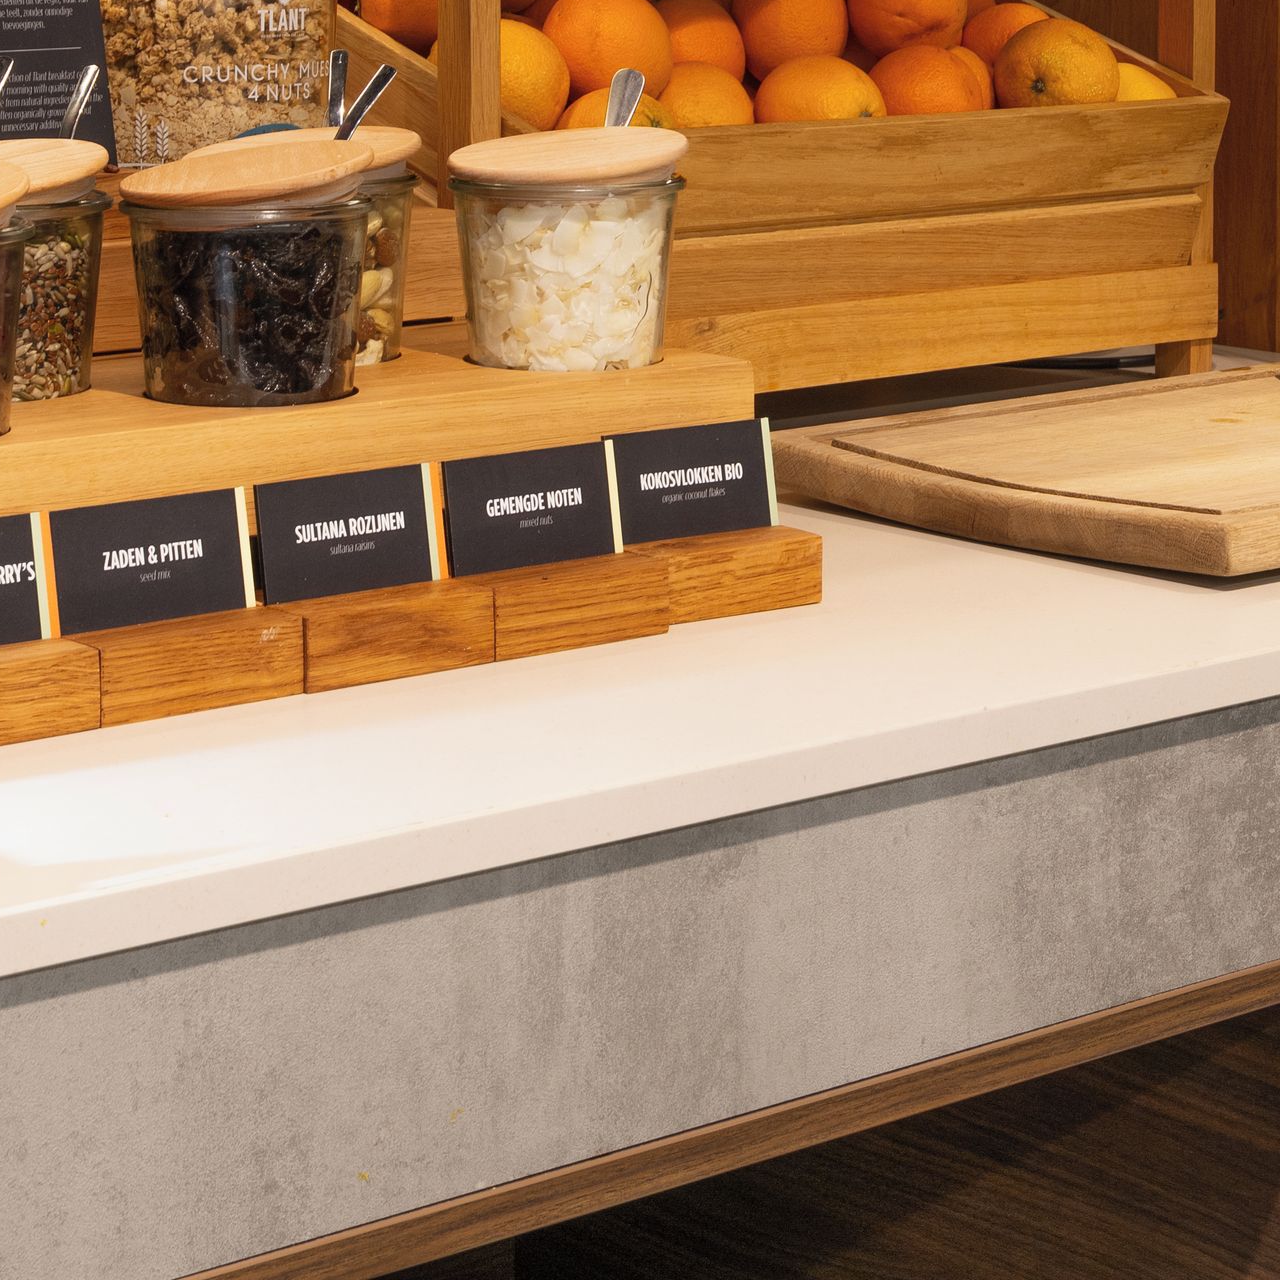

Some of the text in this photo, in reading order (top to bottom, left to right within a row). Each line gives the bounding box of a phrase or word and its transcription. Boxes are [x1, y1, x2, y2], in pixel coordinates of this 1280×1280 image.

[257, 7, 307, 32] TLANT
[25, 72, 31, 81] of
[48, 70, 75, 80] breakfast
[183, 60, 330, 83] CRUNCHY MUES
[7, 85, 32, 95] morning
[34, 84, 47, 93] with
[48, 83, 68, 94] quality
[248, 83, 310, 101] 4 NUTS
[6, 98, 19, 107] from
[21, 96, 43, 106] natural
[1, 122, 38, 132] unnecessary
[640, 462, 743, 490] KOKOSVLOKKEN BIO
[486, 487, 582, 517] GEMENGDE NOTEN
[662, 487, 726, 504] organic coconut flakes
[295, 511, 405, 544] SULTANA ROZIJNEN
[520, 514, 554, 528] mixed nuts
[102, 539, 203, 570] ZADEN & PITTEN
[330, 540, 375, 556] sultana raisins
[140, 569, 171, 583] seed mix
